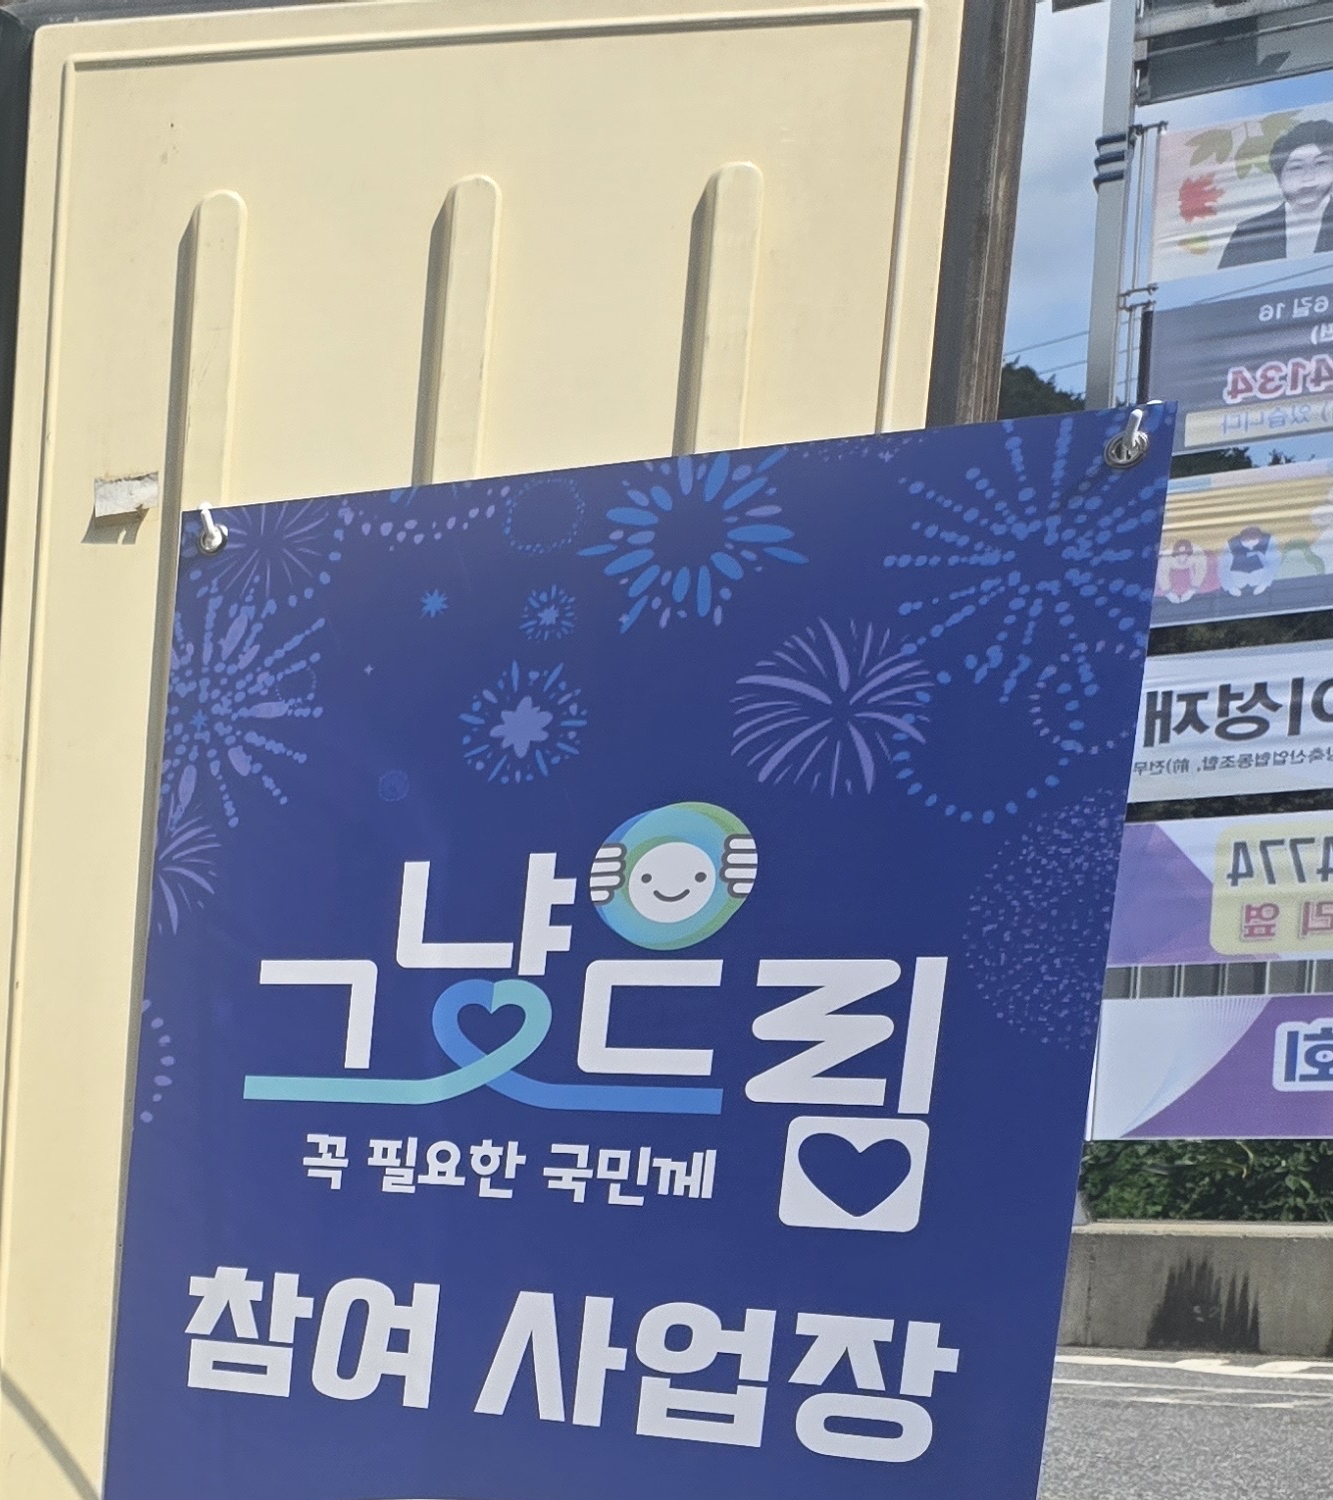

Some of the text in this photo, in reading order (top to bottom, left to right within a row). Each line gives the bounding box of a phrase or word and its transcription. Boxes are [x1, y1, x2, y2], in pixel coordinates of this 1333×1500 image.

[302, 1132, 718, 1207] 꼭 필요한 국민께
[184, 1265, 960, 1463] 참여 사업장
